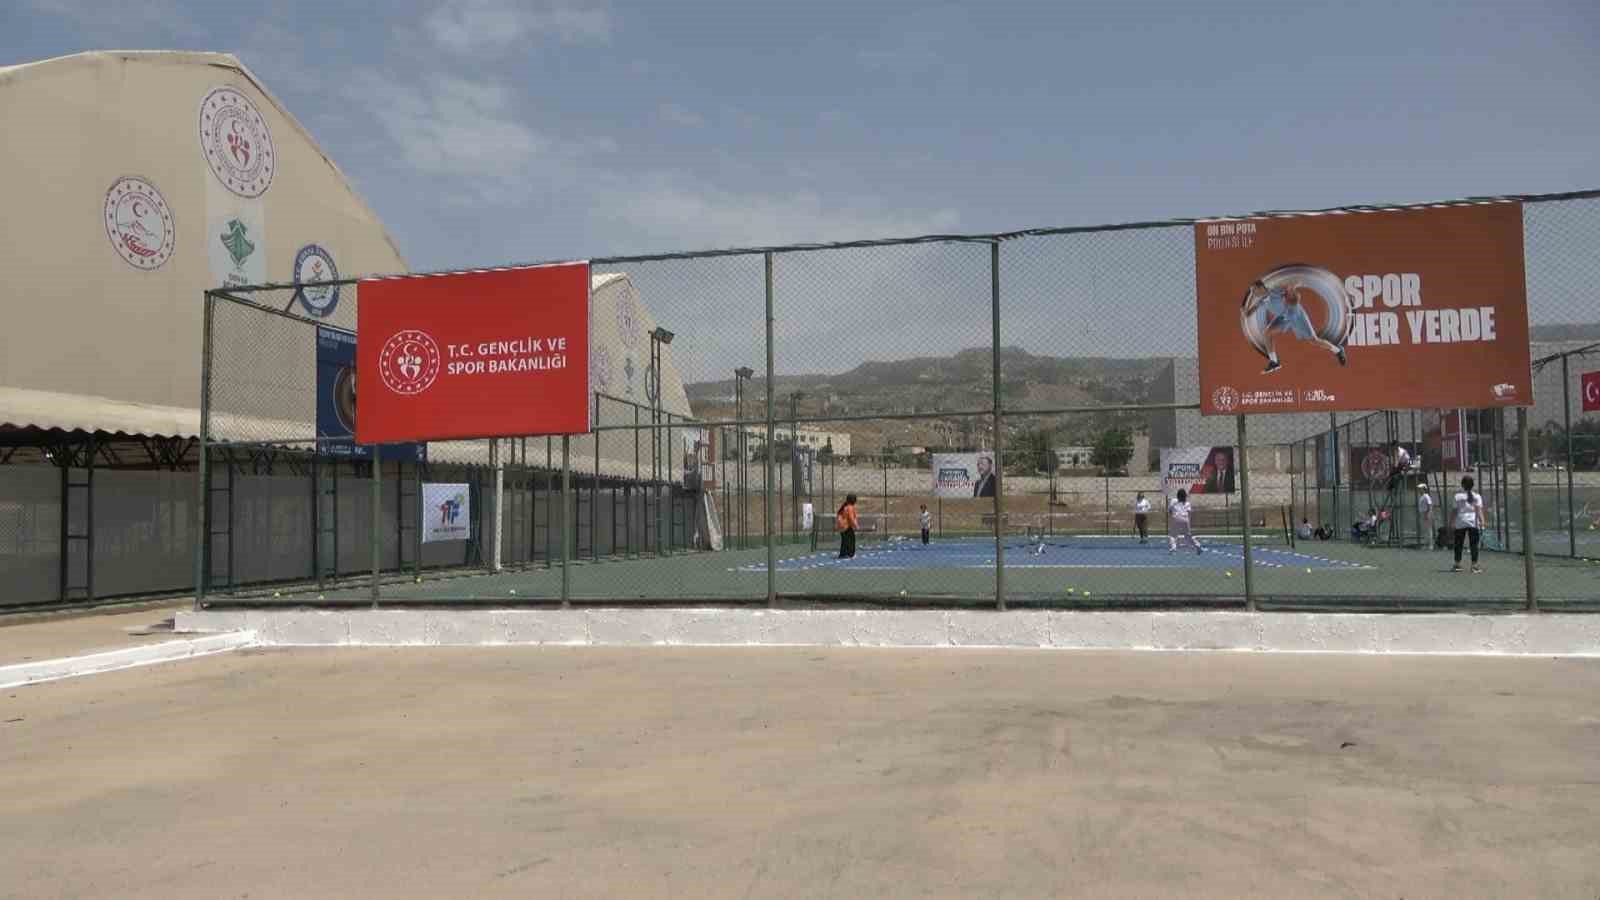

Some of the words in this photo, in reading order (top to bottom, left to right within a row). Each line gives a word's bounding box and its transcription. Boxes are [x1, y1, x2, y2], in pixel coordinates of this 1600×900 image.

[1236, 223, 1256, 235] POTA
[1344, 272, 1422, 309] SPOR
[1405, 306, 1497, 345] YERDE
[447, 344, 474, 358] T.C.
[478, 336, 543, 358] GENÇLİK
[547, 337, 566, 352] VE
[447, 361, 485, 375] SPOR
[488, 353, 567, 373] BAKANLIĞI
